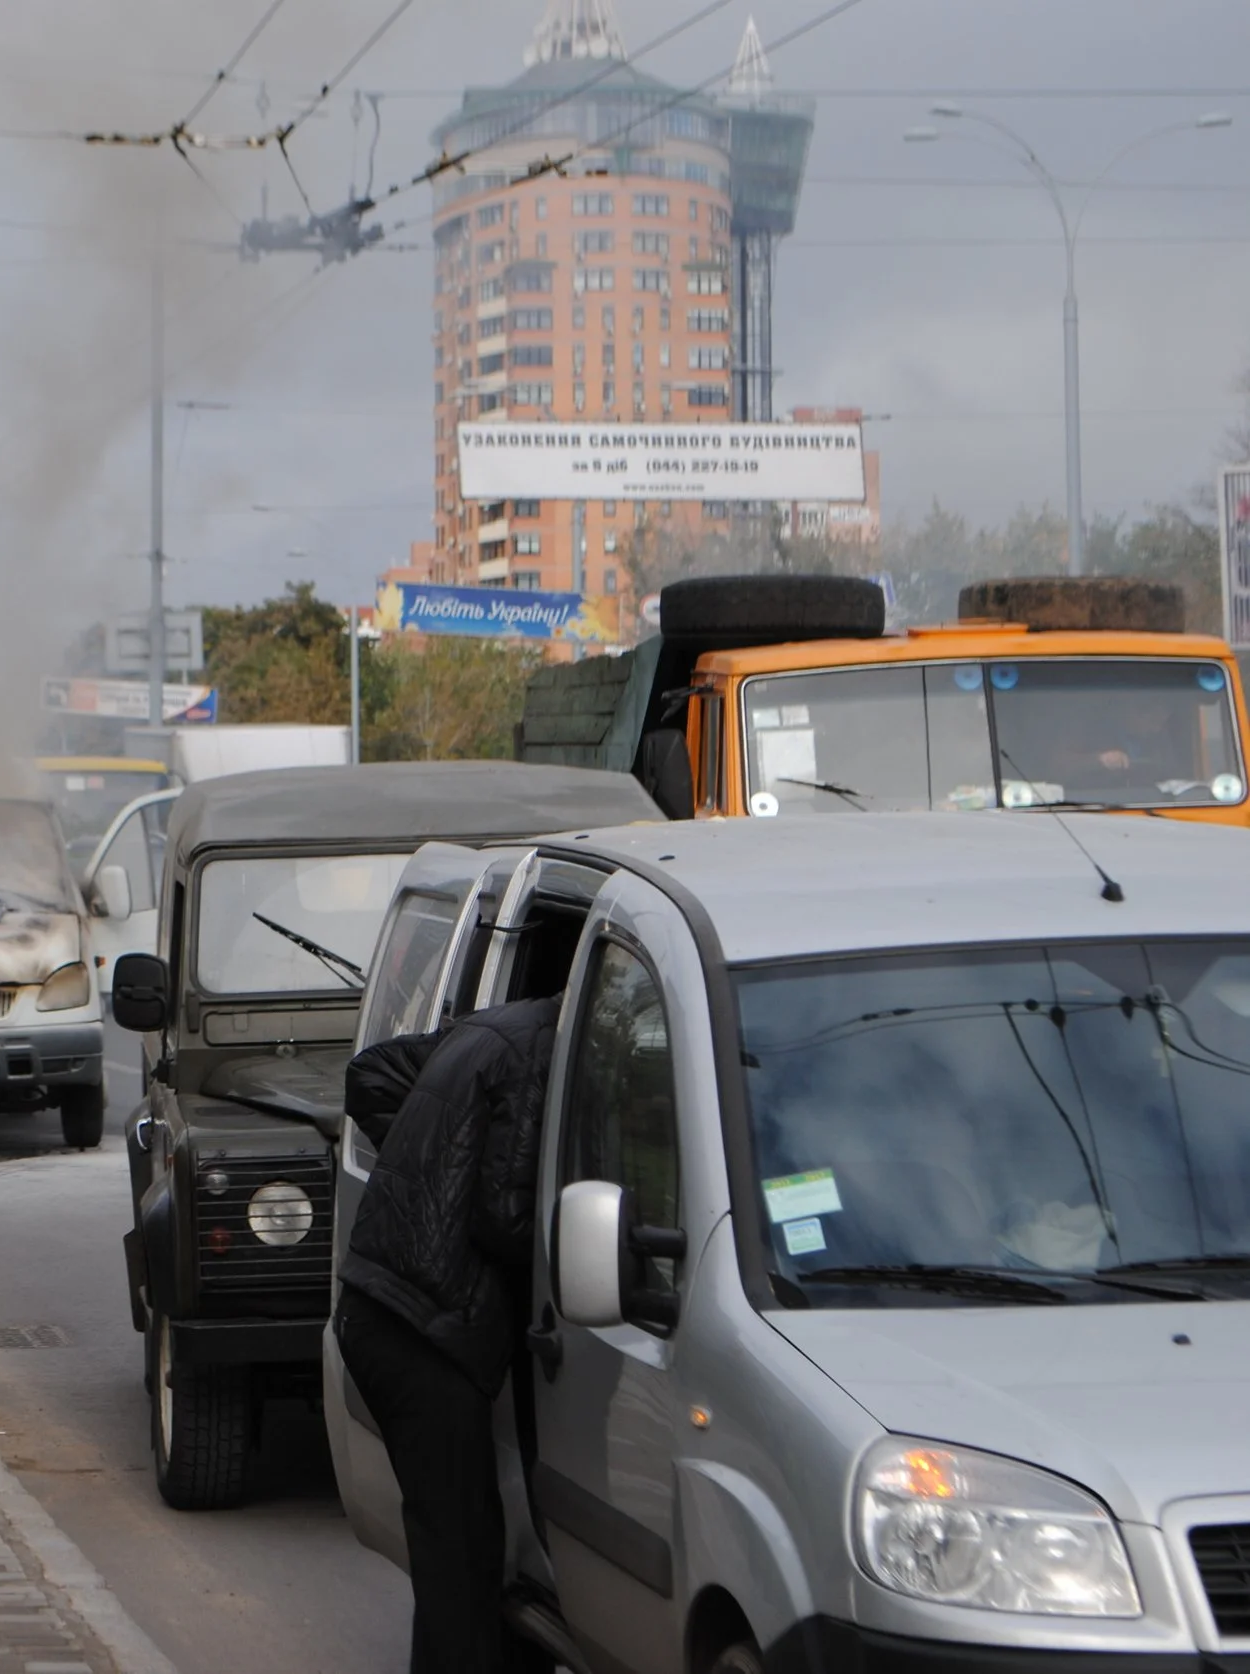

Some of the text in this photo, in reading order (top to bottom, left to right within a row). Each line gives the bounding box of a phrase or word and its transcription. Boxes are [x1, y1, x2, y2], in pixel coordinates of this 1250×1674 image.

[462, 432, 857, 451] УЗАКОНЕННЯ САМОЧИННОГО БУДІВНИЦТВА
[571, 460, 588, 473] за
[606, 458, 628, 475] діб
[646, 458, 687, 475] (044)
[691, 458, 759, 474] 227-19-19
[409, 595, 569, 628] Любіть Україну!
